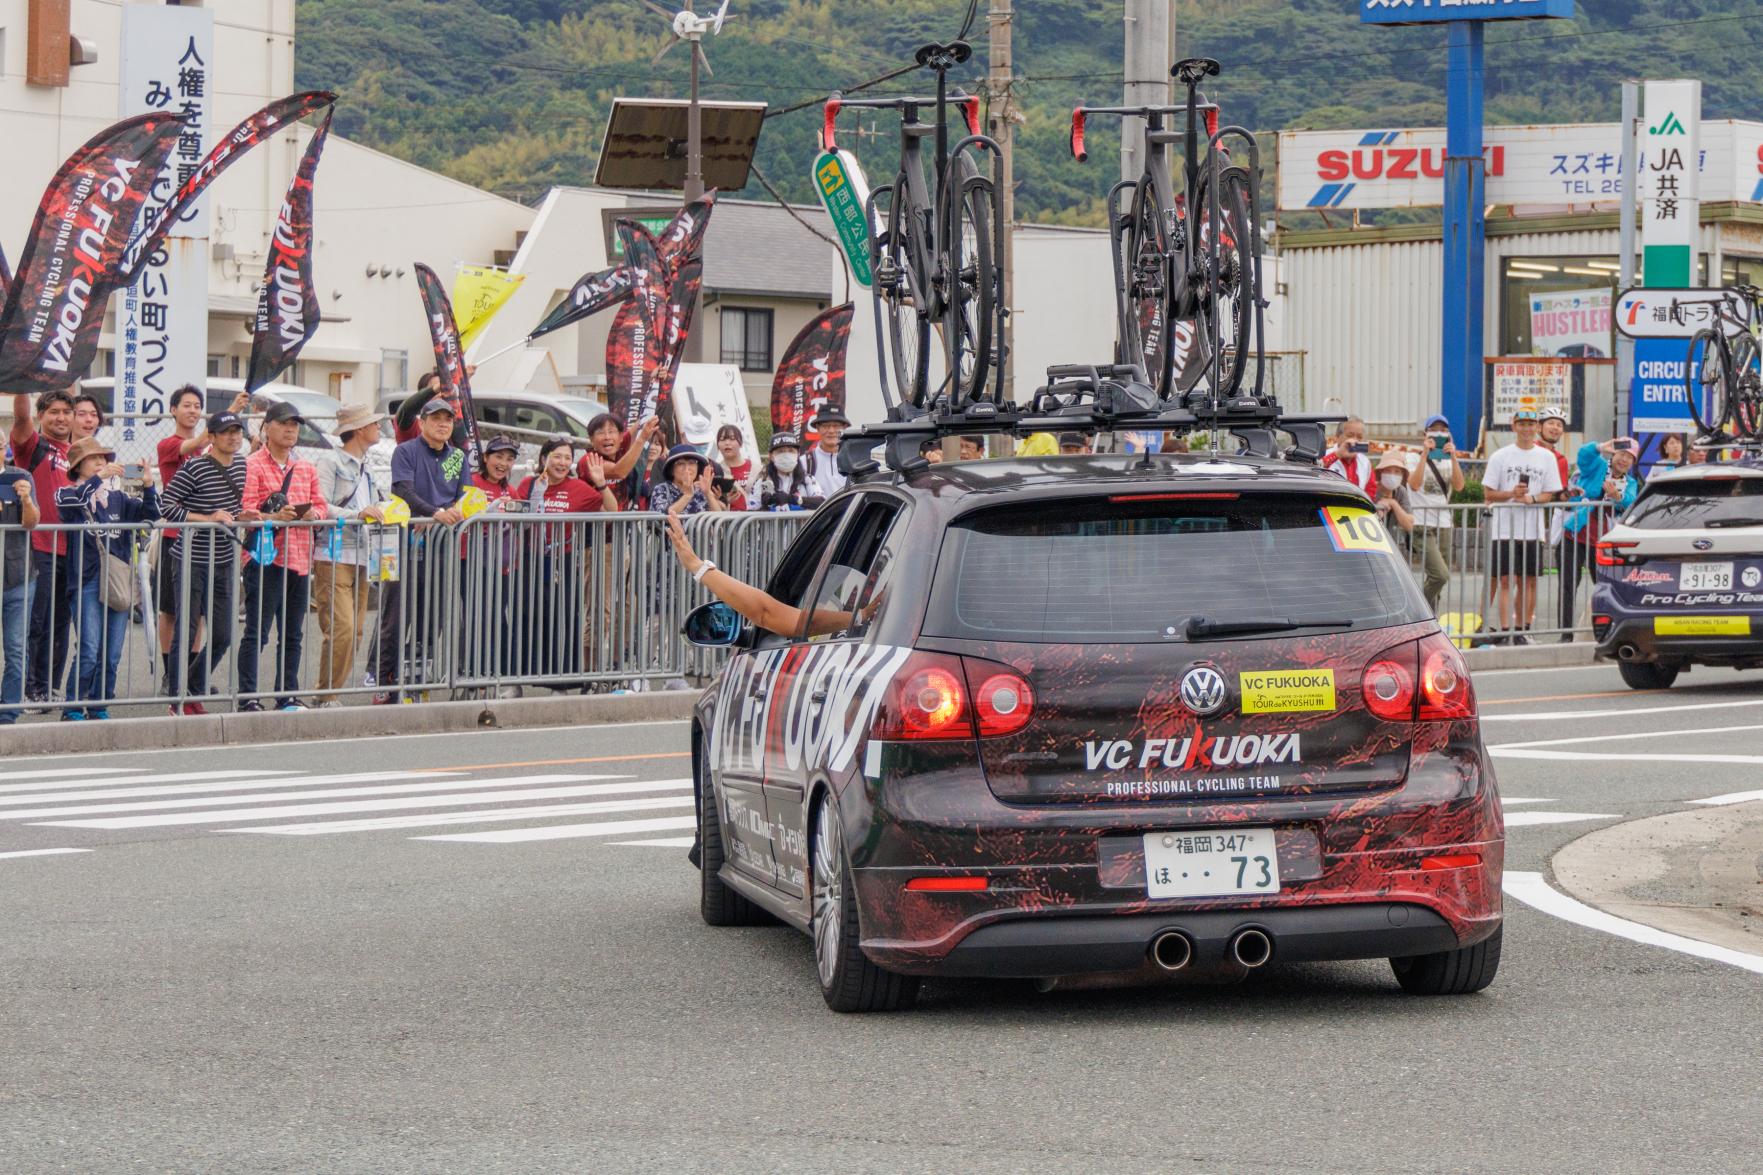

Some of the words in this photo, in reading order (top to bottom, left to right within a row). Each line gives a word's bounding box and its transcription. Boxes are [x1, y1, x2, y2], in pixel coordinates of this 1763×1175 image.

[1317, 146, 1505, 181] SUZUI
[101, 158, 141, 202] VC
[1563, 180, 1595, 193] TEL
[53, 171, 96, 254] PROFESSIONAL
[39, 257, 63, 308] CYCLING
[43, 203, 113, 372] FUKUOKA
[28, 311, 50, 343] TEAM
[1533, 309, 1611, 337] HUSTLER
[631, 321, 645, 393] PROFESSIONAL
[1638, 361, 1699, 379] CIRCUT
[1336, 516, 1383, 542] 10
[1691, 573, 1729, 587] 91-98
[1641, 594, 1673, 604] Pro
[1675, 592, 1735, 605] Cycling
[1245, 679, 1264, 689] VC
[1266, 676, 1330, 688] FUKUOKA
[1085, 740, 1133, 770] VC
[1138, 724, 1300, 771] FUKUOKA
[1107, 780, 1193, 795] PROFESSIONAL
[1197, 777, 1245, 792] CYCLING
[1249, 775, 1280, 790] TEAM
[1176, 836, 1212, 854] 福岡
[1216, 835, 1246, 852] 347
[1155, 867, 1172, 885] ほ
[1231, 855, 1272, 888] 73
